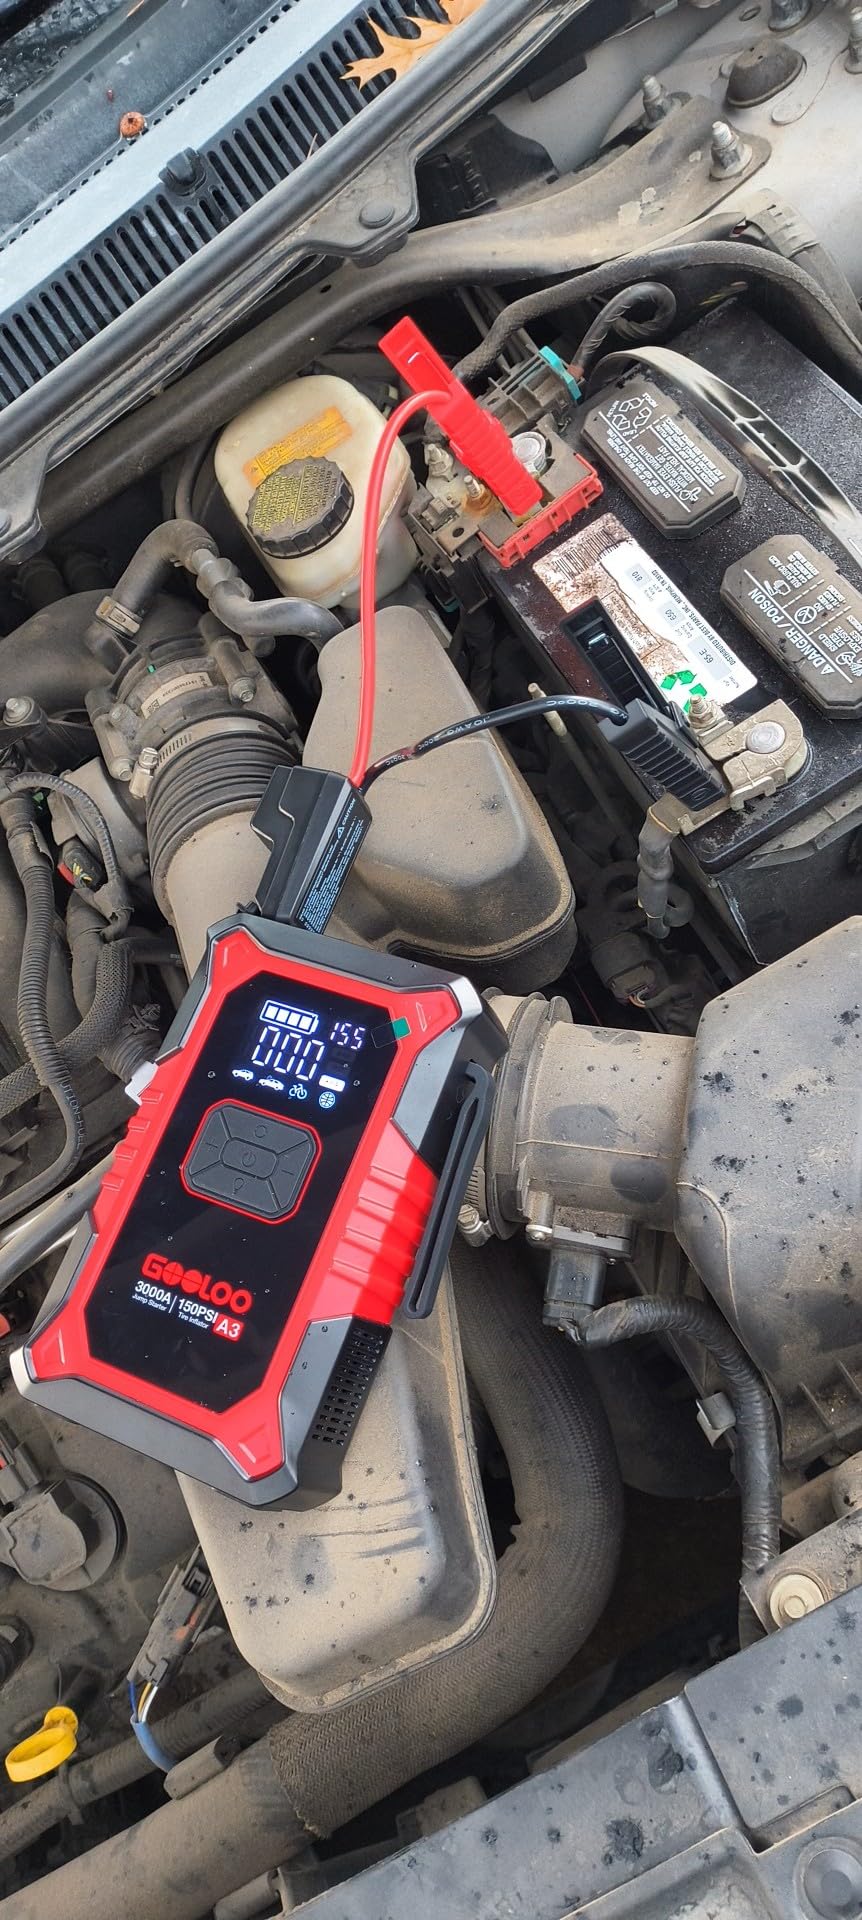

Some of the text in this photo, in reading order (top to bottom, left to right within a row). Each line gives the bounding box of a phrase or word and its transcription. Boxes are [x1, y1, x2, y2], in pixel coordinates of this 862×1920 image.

[635, 443, 682, 492] FLUSH EYES IMMEDIATELY
[657, 445, 695, 482] MEDICAL HELP FAST
[767, 554, 801, 588] SULFURIC ACID
[747, 588, 784, 623] POISON
[698, 623, 710, 636] BEST
[818, 633, 839, 653] SHIELD
[829, 632, 846, 648] EYES
[834, 625, 862, 654] EXPLOSIVE
[711, 638, 736, 666] DISTRIBUTED
[784, 627, 826, 667] DANGER
[342, 798, 356, 825] CAUTION
[251, 1025, 324, 1081] 000
[329, 1022, 366, 1050] 155
[142, 1253, 252, 1314] GOOLOO
[135, 1281, 241, 1338] 3000A 150PSI A3
